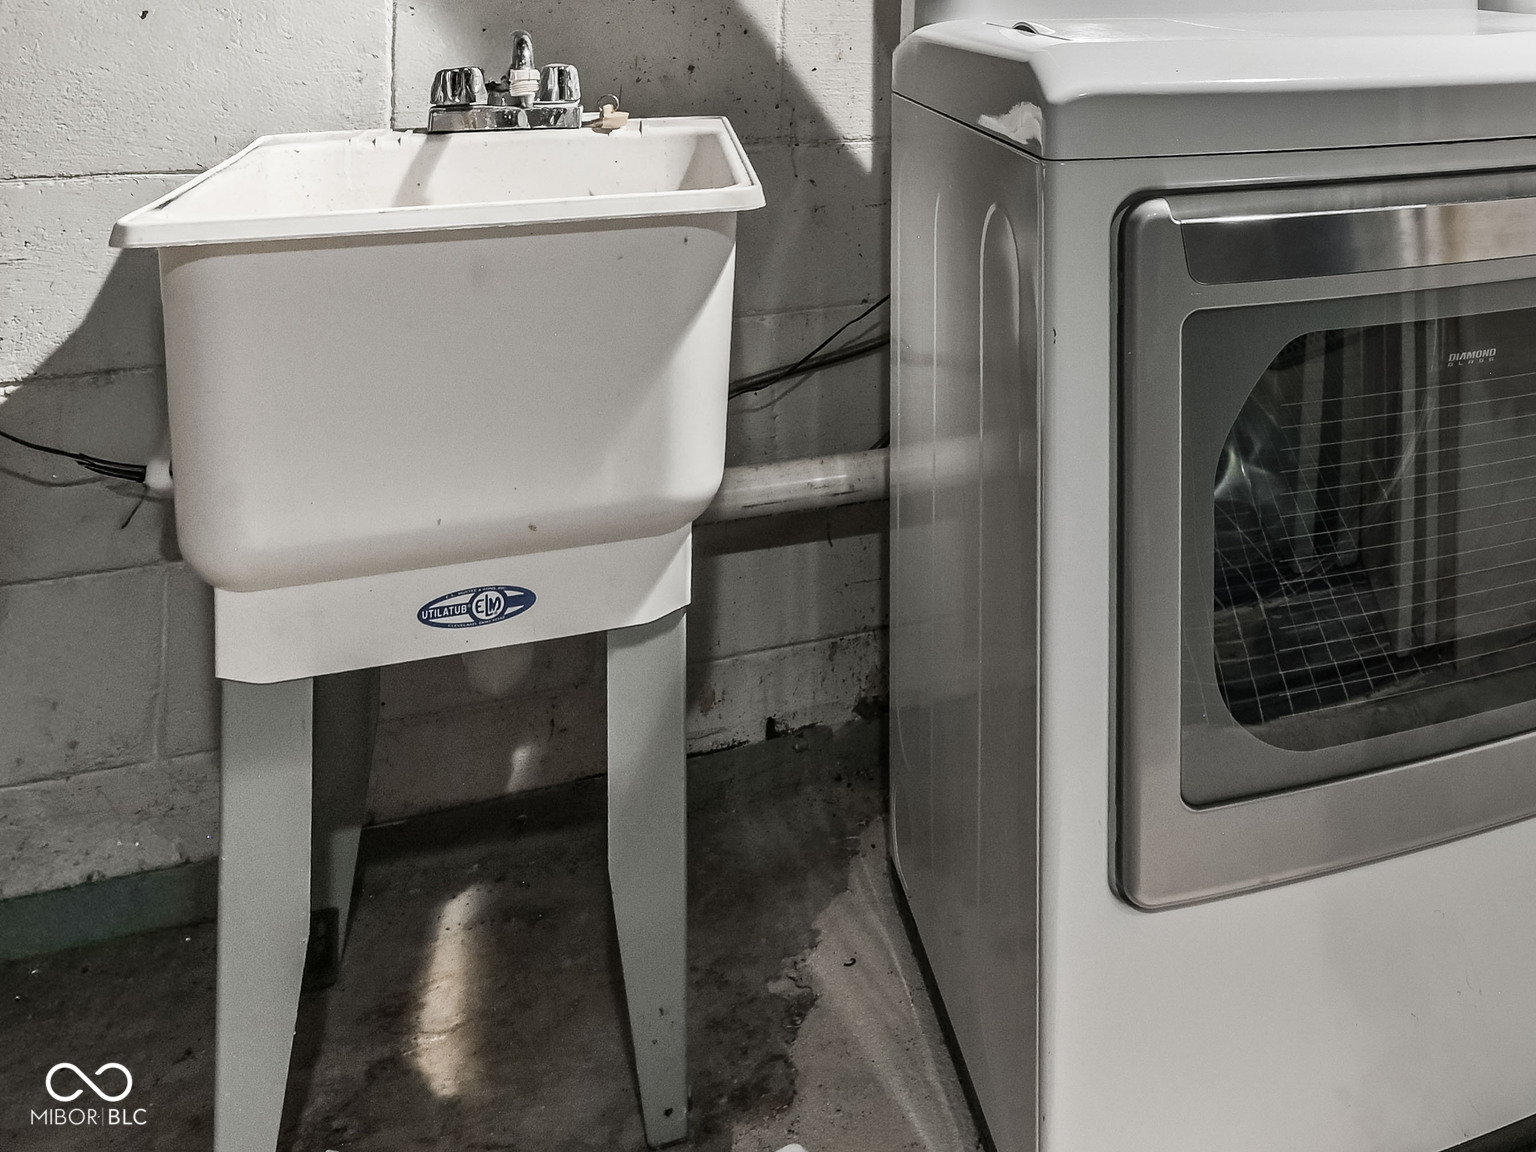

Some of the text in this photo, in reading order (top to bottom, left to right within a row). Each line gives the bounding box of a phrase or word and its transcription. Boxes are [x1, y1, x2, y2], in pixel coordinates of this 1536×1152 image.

[1448, 348, 1497, 362] DIAMOND
[421, 604, 468, 620] UTILATUB
[475, 593, 502, 618] ELM
